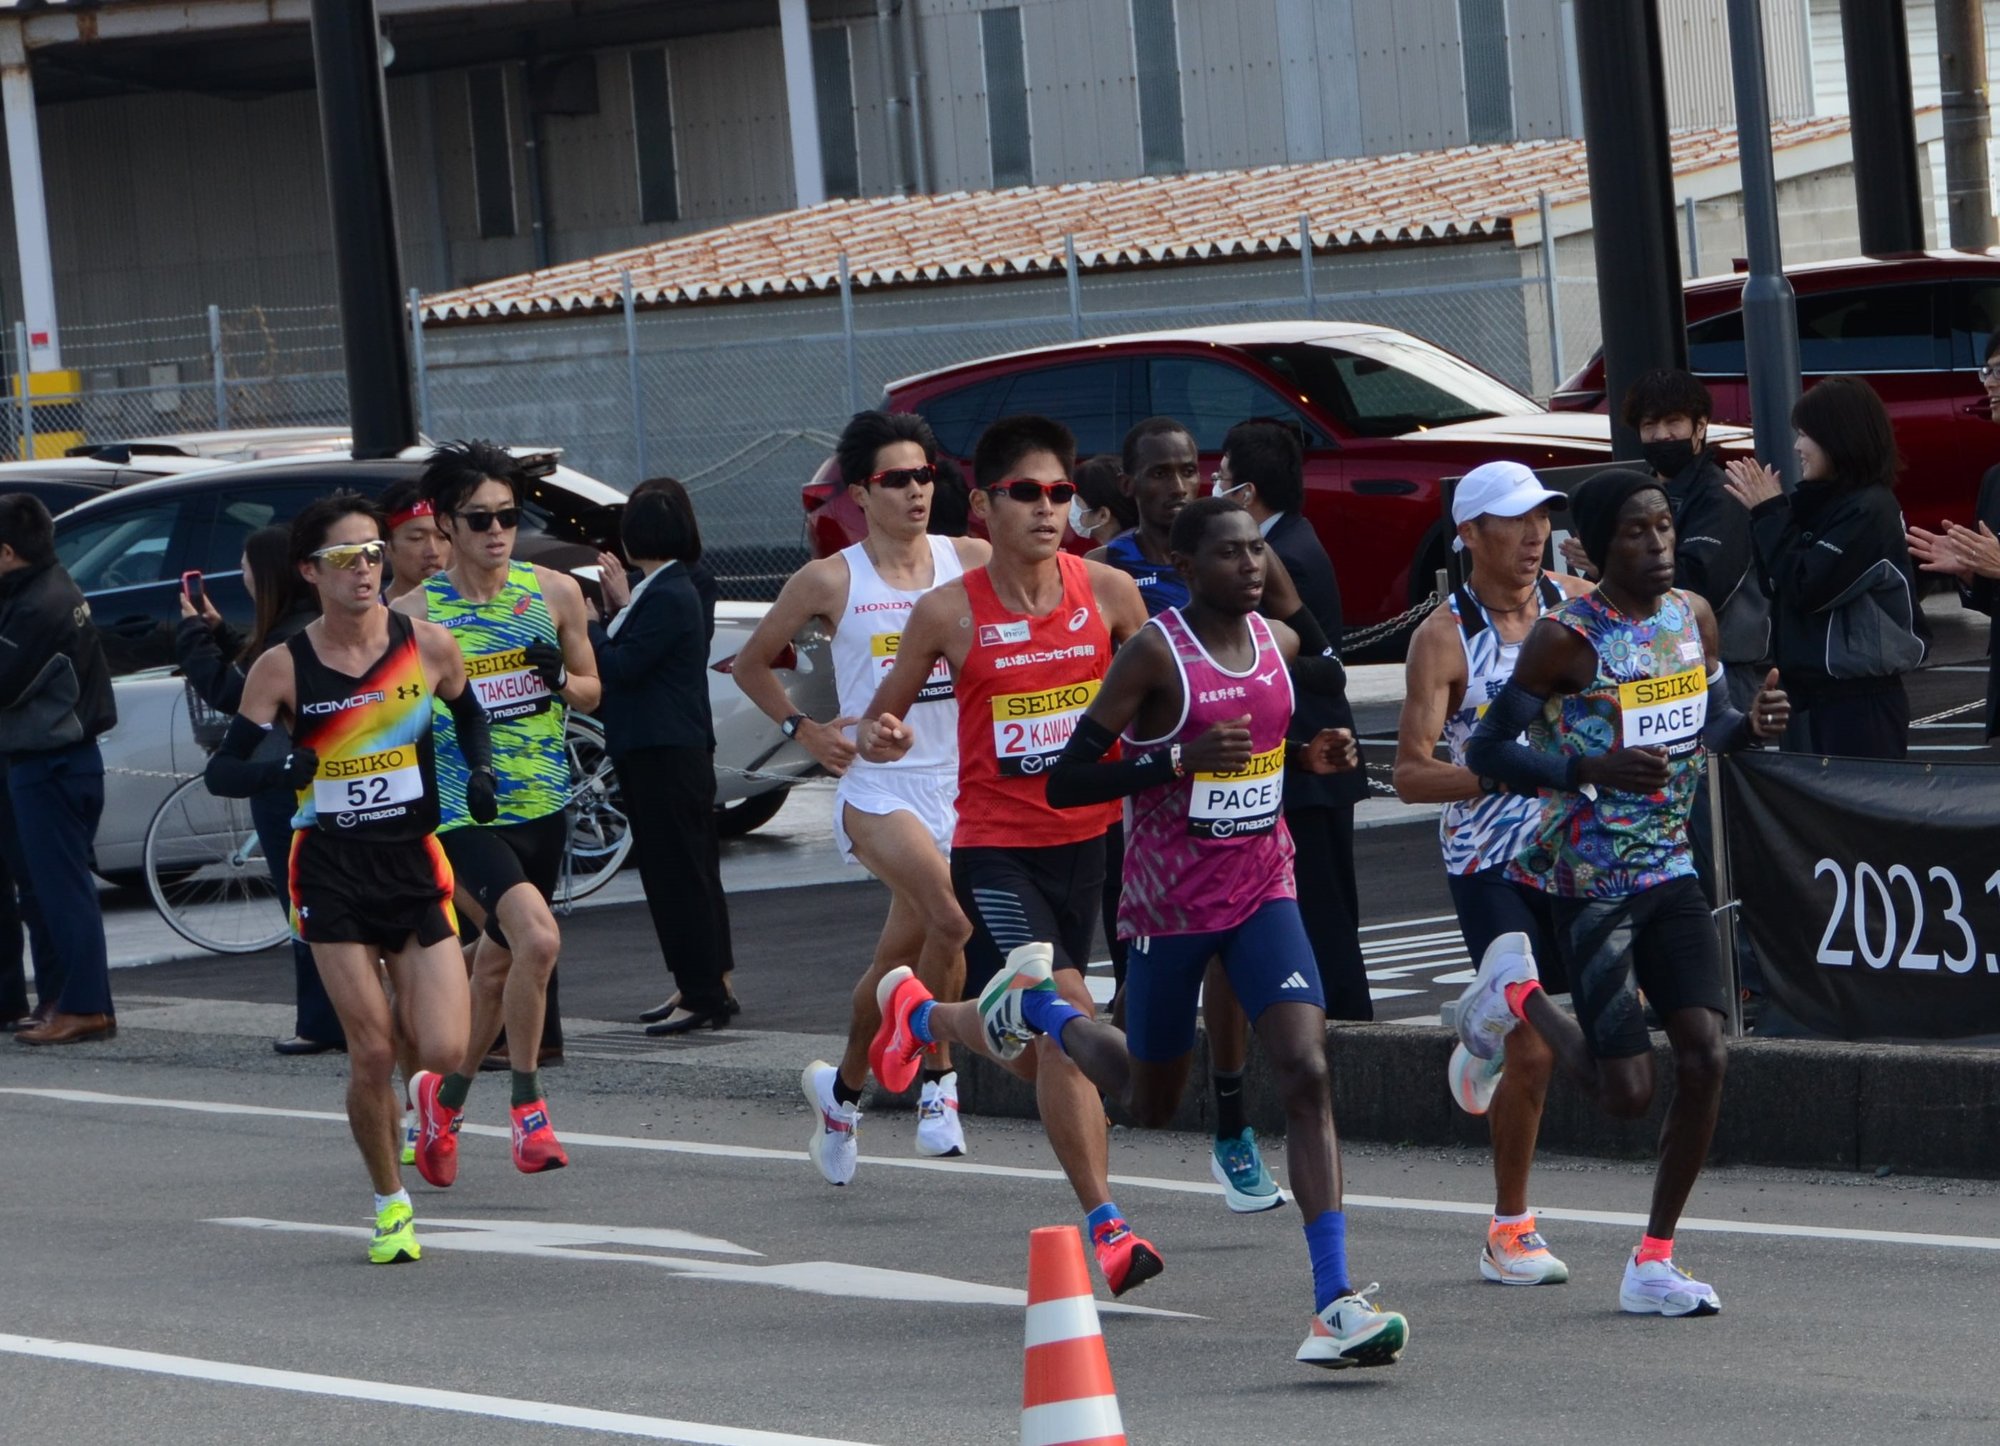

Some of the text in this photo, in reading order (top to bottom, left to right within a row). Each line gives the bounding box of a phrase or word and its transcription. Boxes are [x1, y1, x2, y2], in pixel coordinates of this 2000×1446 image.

[854, 601, 913, 615] HONDA
[994, 644, 1096, 670] あいおいニッセイ同和
[477, 674, 547, 704] TAKEUCH
[918, 684, 954, 698] mazd
[1007, 686, 1090, 717] SEIKO
[1635, 672, 1701, 704] SEIKO
[302, 690, 385, 715] KOMORI
[493, 703, 537, 719] mazda
[1638, 706, 1694, 737] PACE
[1003, 722, 1027, 754] 2
[325, 750, 404, 777] SEIKO
[347, 776, 391, 807] 52
[1207, 783, 1272, 811] PACE
[359, 806, 407, 822] mazda
